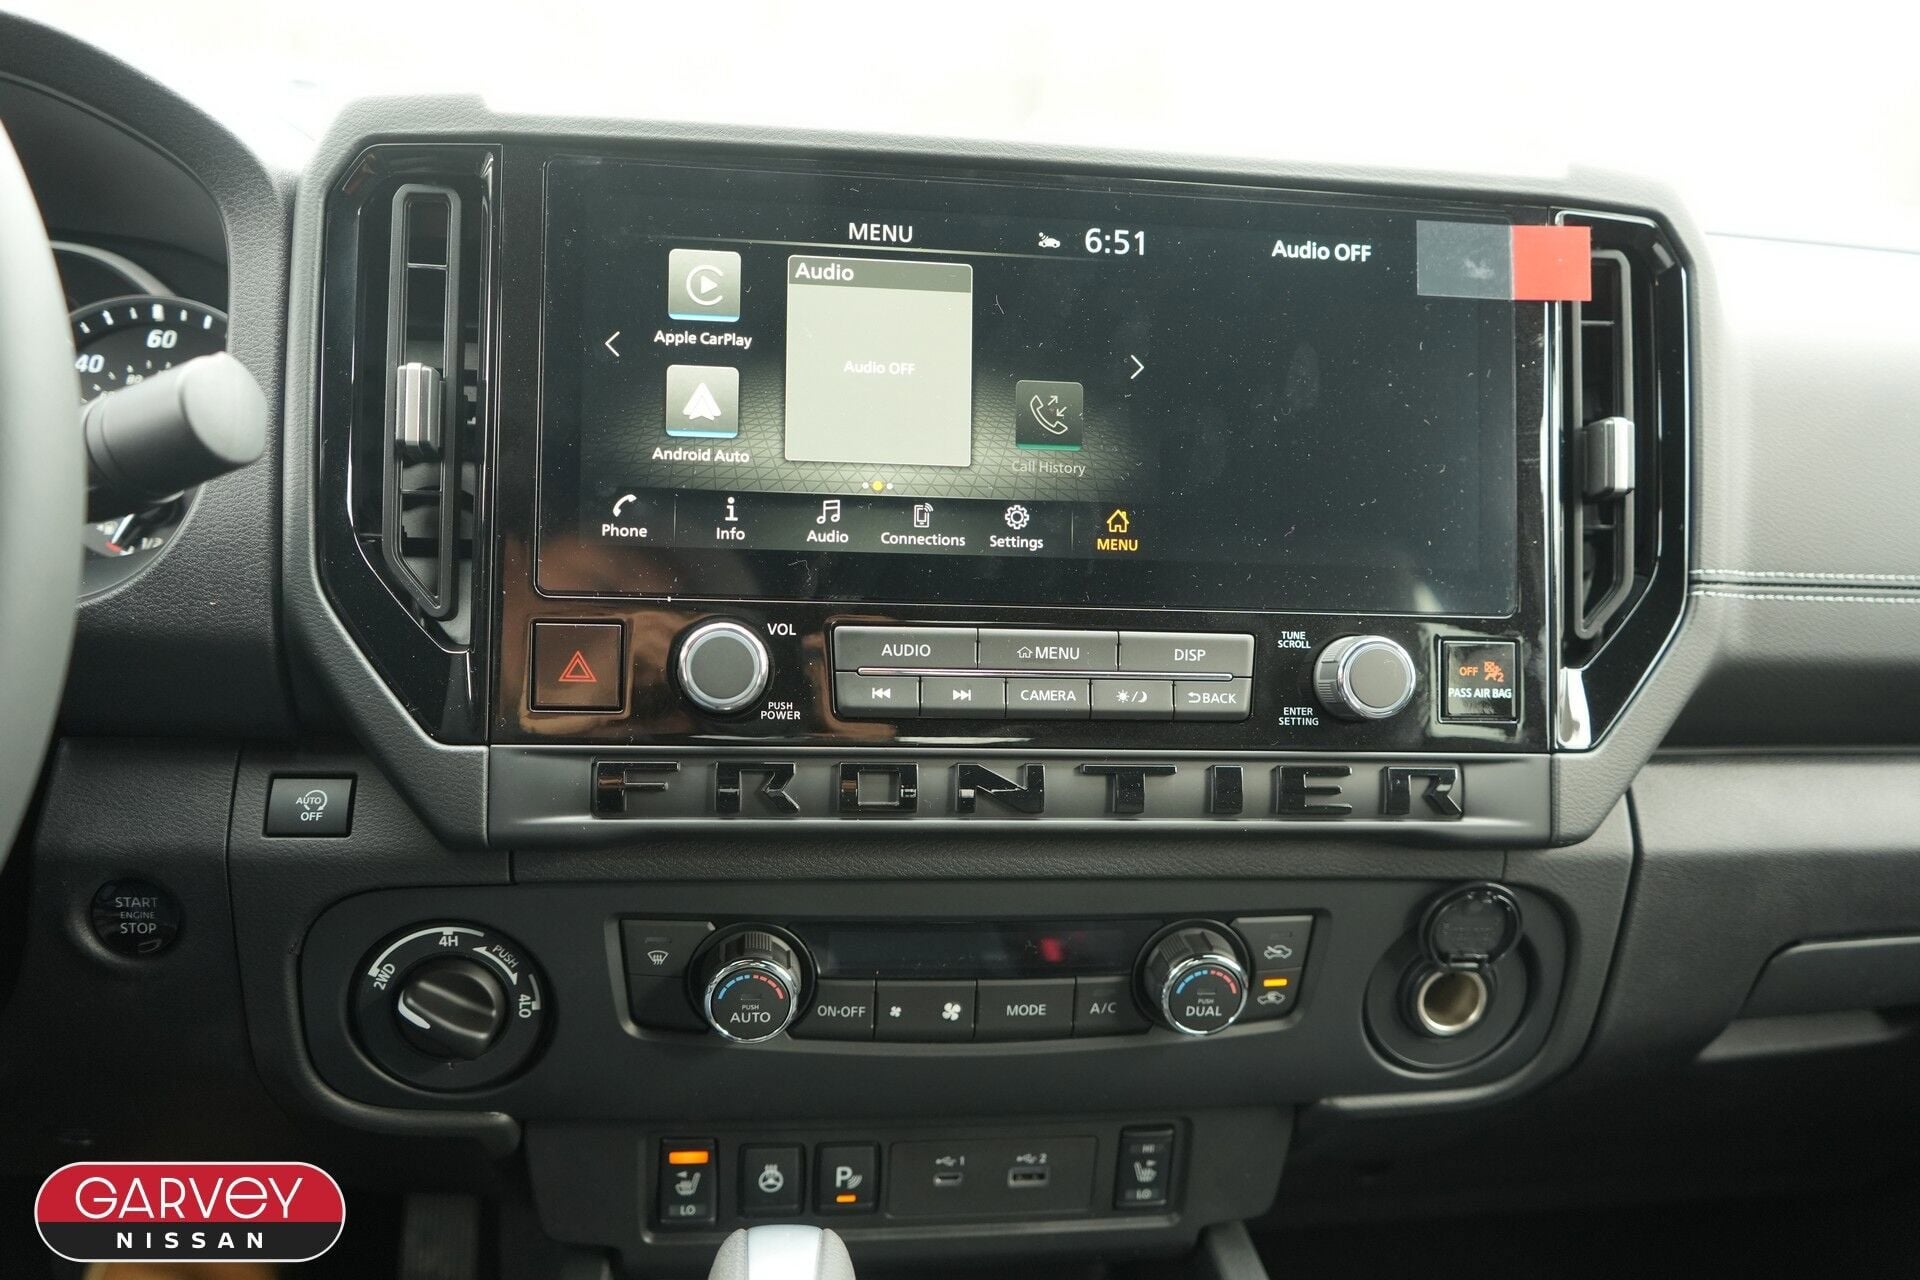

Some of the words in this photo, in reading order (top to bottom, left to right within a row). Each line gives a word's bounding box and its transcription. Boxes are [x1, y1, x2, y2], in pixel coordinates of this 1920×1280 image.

[848, 222, 914, 243] MENU
[1085, 227, 1146, 256] 6:51
[1271, 239, 1331, 260] Audio
[1334, 243, 1372, 262] OFF
[795, 262, 854, 282] Audio
[146, 329, 178, 349] 60
[653, 329, 697, 347] Apple
[699, 332, 753, 350] CarPlay
[75, 354, 105, 374] 40
[843, 360, 886, 376] Audio
[888, 361, 916, 376] OFF
[651, 446, 710, 464] Android
[714, 449, 750, 464] Auto
[1011, 460, 1036, 473] Call
[1039, 462, 1086, 478] History
[601, 524, 648, 539] Phone
[715, 527, 746, 541] Info
[807, 530, 849, 544] Audio
[880, 531, 966, 548] Connections
[989, 535, 1044, 552] Settings
[1096, 538, 1139, 552] MENU
[767, 622, 797, 638] VOL
[1281, 631, 1306, 641] TUNE
[881, 644, 932, 659] AUDIO
[1277, 639, 1312, 650] SCROLL
[1034, 646, 1081, 661] MENU
[1173, 648, 1206, 663] DISP
[1459, 666, 1479, 677] OFF
[1020, 690, 1077, 703] CAMERA
[1202, 692, 1237, 705] BACK
[1448, 688, 1472, 699] PASS
[1473, 689, 1491, 699] AIR
[1492, 689, 1512, 700] BAG
[768, 701, 793, 711] PUSH
[1283, 707, 1314, 717] ENTER
[760, 709, 801, 721] POWER
[1278, 716, 1320, 727] SETTING
[590, 760, 1465, 818] FRONTIER
[296, 797, 322, 805] AUTO
[300, 812, 323, 822] OFF
[115, 896, 159, 908] START
[120, 911, 155, 919] ENGINE
[120, 922, 157, 934] STOP
[438, 935, 459, 947] 4H
[492, 944, 519, 969] PUSH
[373, 962, 396, 991] 2WD
[518, 993, 532, 1019] 4LO
[1005, 1004, 1047, 1017] MODE
[1089, 1001, 1117, 1014] A/C
[1186, 1006, 1223, 1018] DUAL
[730, 1012, 771, 1024] AUTO
[679, 1204, 697, 1217] LO
